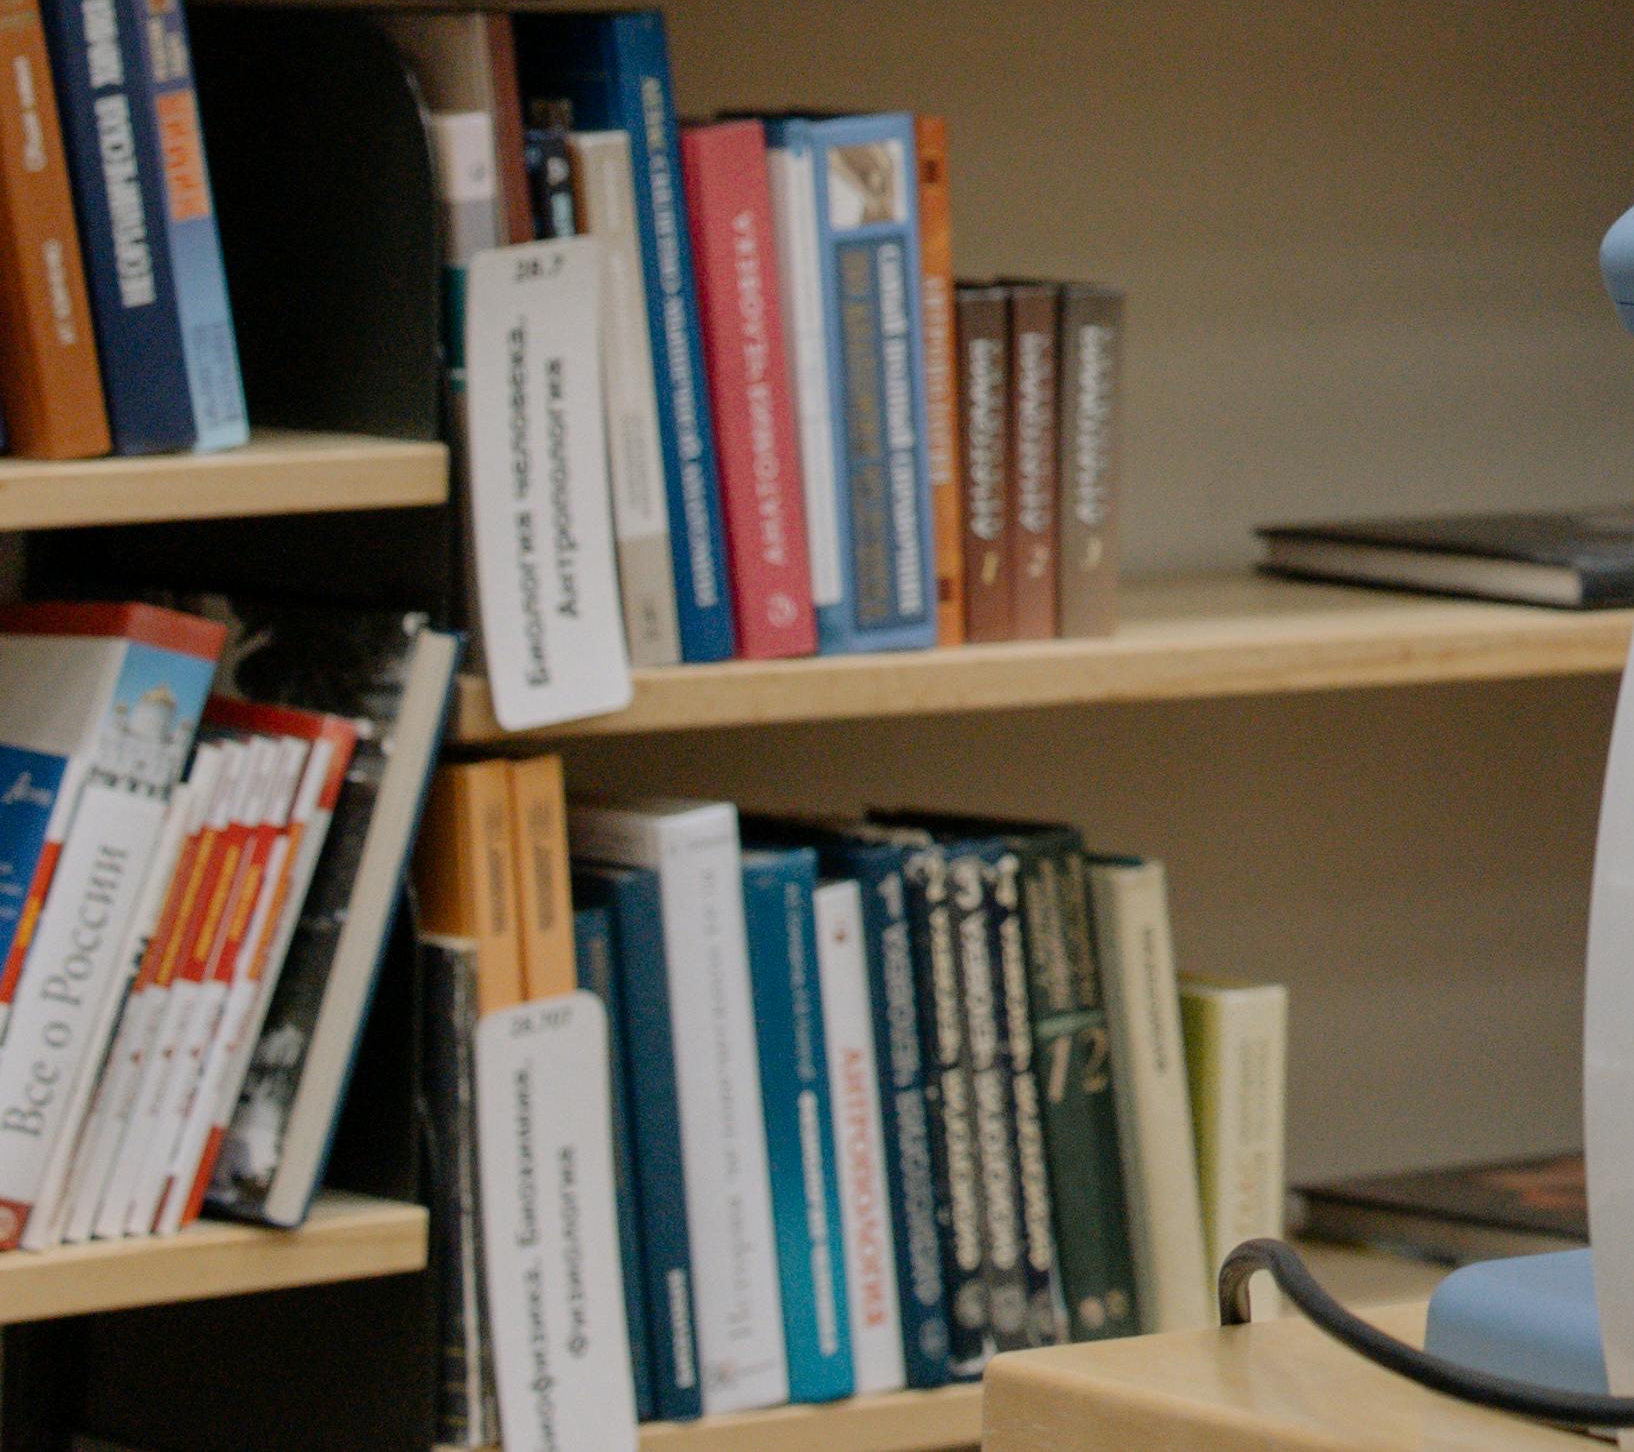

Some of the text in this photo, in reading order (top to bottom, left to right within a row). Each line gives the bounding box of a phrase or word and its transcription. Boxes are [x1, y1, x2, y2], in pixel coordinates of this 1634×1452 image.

[501, 315, 552, 688] Биология человека.
[542, 356, 582, 620] Антропология
[731, 208, 791, 567] АНАТОМИЯ ЧЕЛОВЕКА
[2, 844, 129, 1139] Все о России
[510, 1057, 558, 1452] иофизика. Биохимия.
[555, 1144, 592, 1359] Физиология
